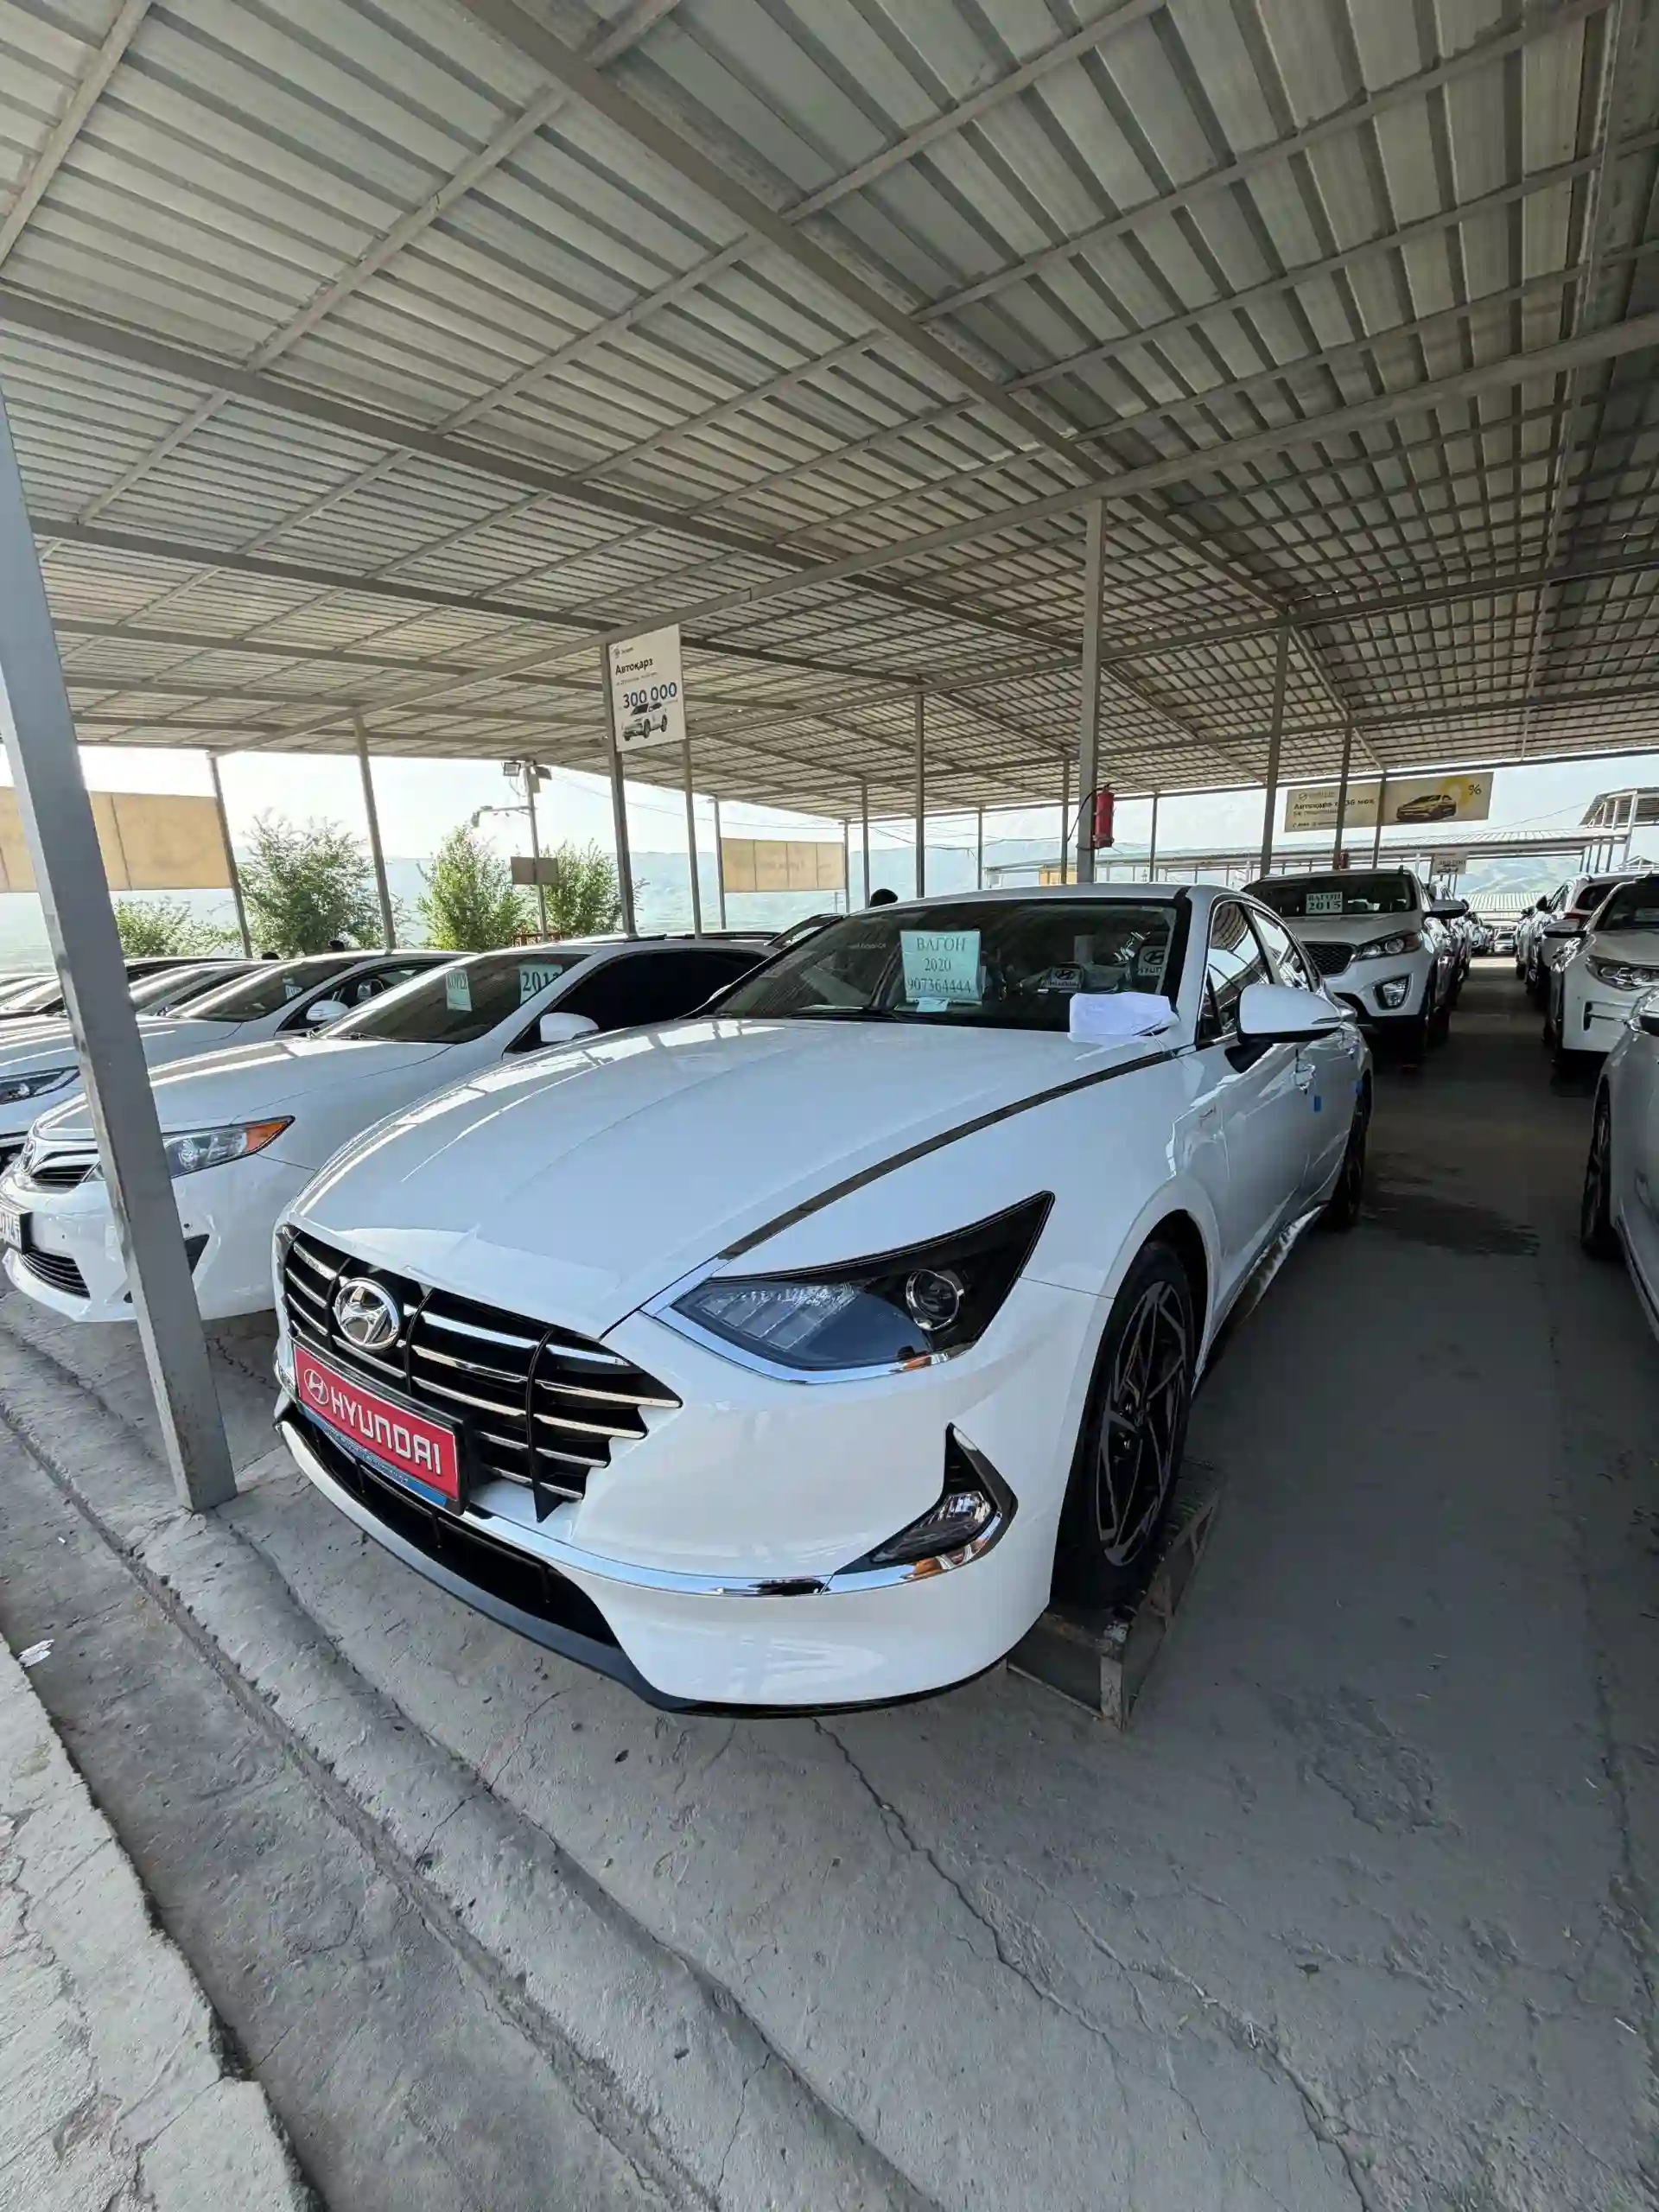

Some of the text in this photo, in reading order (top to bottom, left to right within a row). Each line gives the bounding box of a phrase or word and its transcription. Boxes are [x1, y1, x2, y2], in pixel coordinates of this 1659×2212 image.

[615, 658, 653, 676] Автоқарз
[623, 682, 677, 709] 300 000
[1308, 900, 1342, 911] 2015
[916, 938, 967, 951] ВАГОН
[924, 957, 951, 972] 2020
[907, 977, 972, 993] 907364444
[330, 1386, 442, 1476] HYUNDAI
